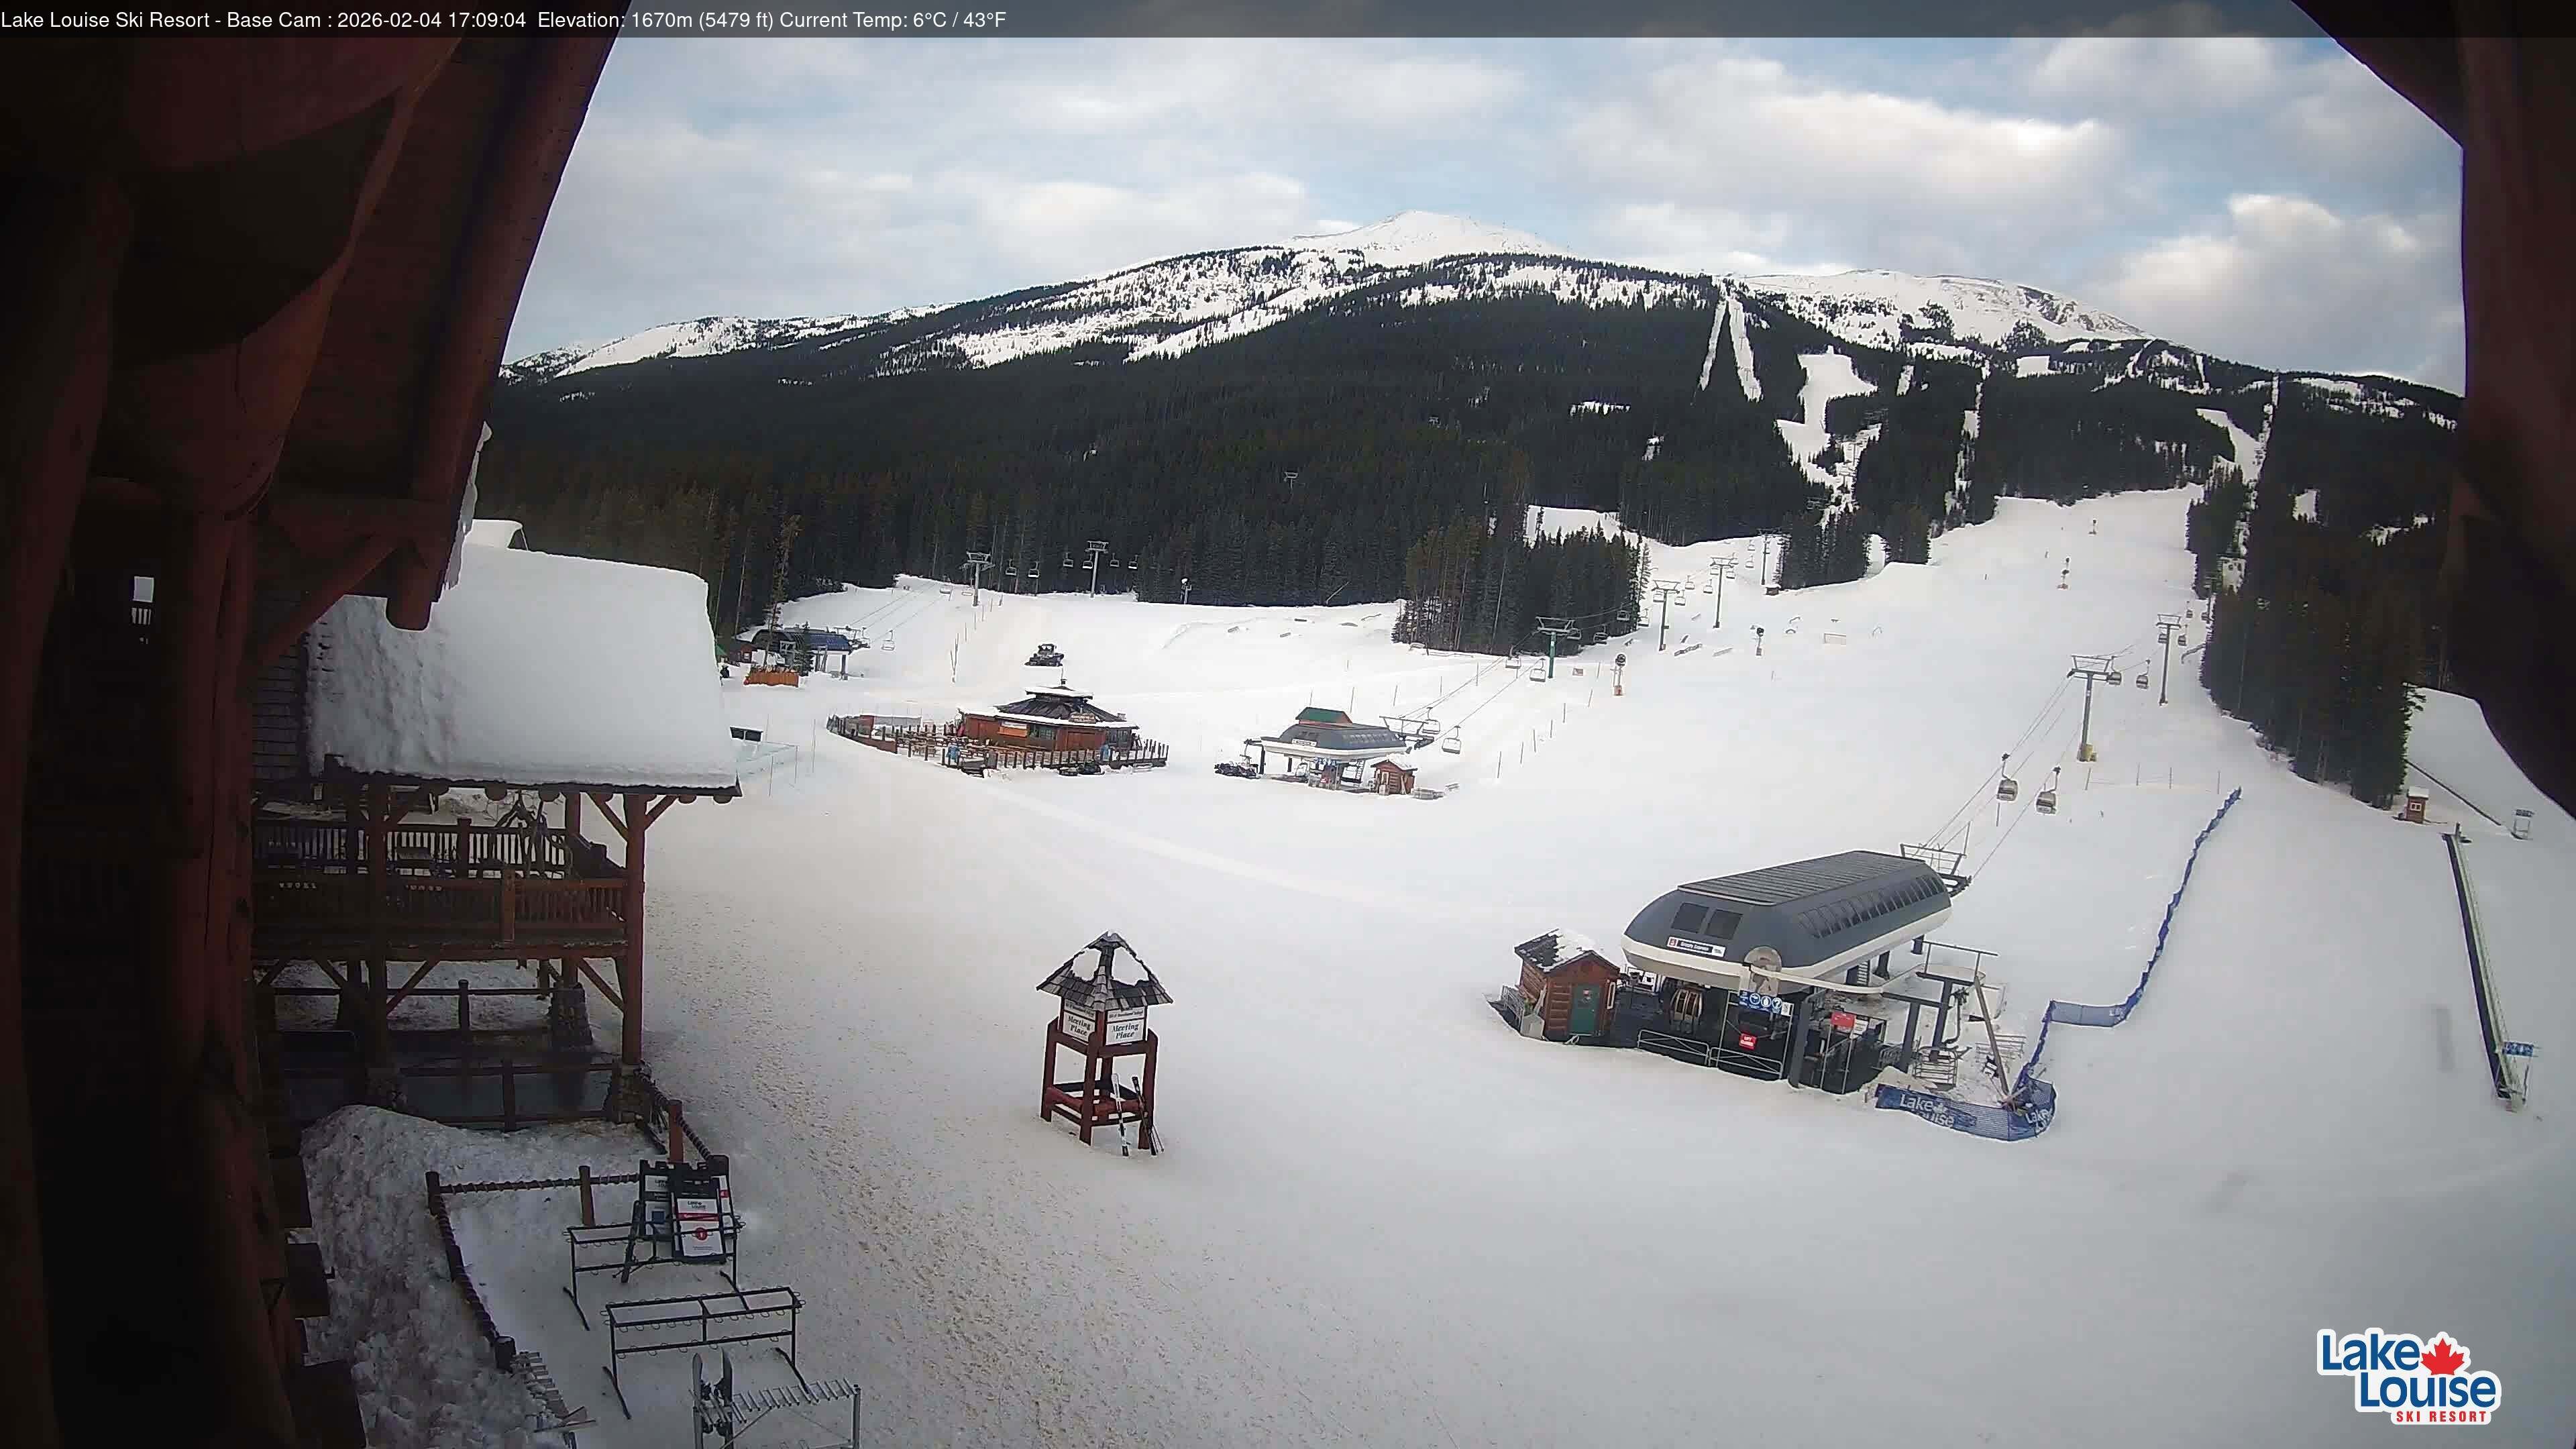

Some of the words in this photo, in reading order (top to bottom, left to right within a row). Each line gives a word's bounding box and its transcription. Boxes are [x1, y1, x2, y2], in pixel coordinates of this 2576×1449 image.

[1070, 1024, 1087, 1036] Place
[1112, 1022, 1140, 1032] Meeting
[1116, 1031, 1134, 1039] Place
[1899, 1093, 1933, 1112] Lake
[1914, 1110, 1955, 1128] ouise
[2025, 1108, 2050, 1124] Lake
